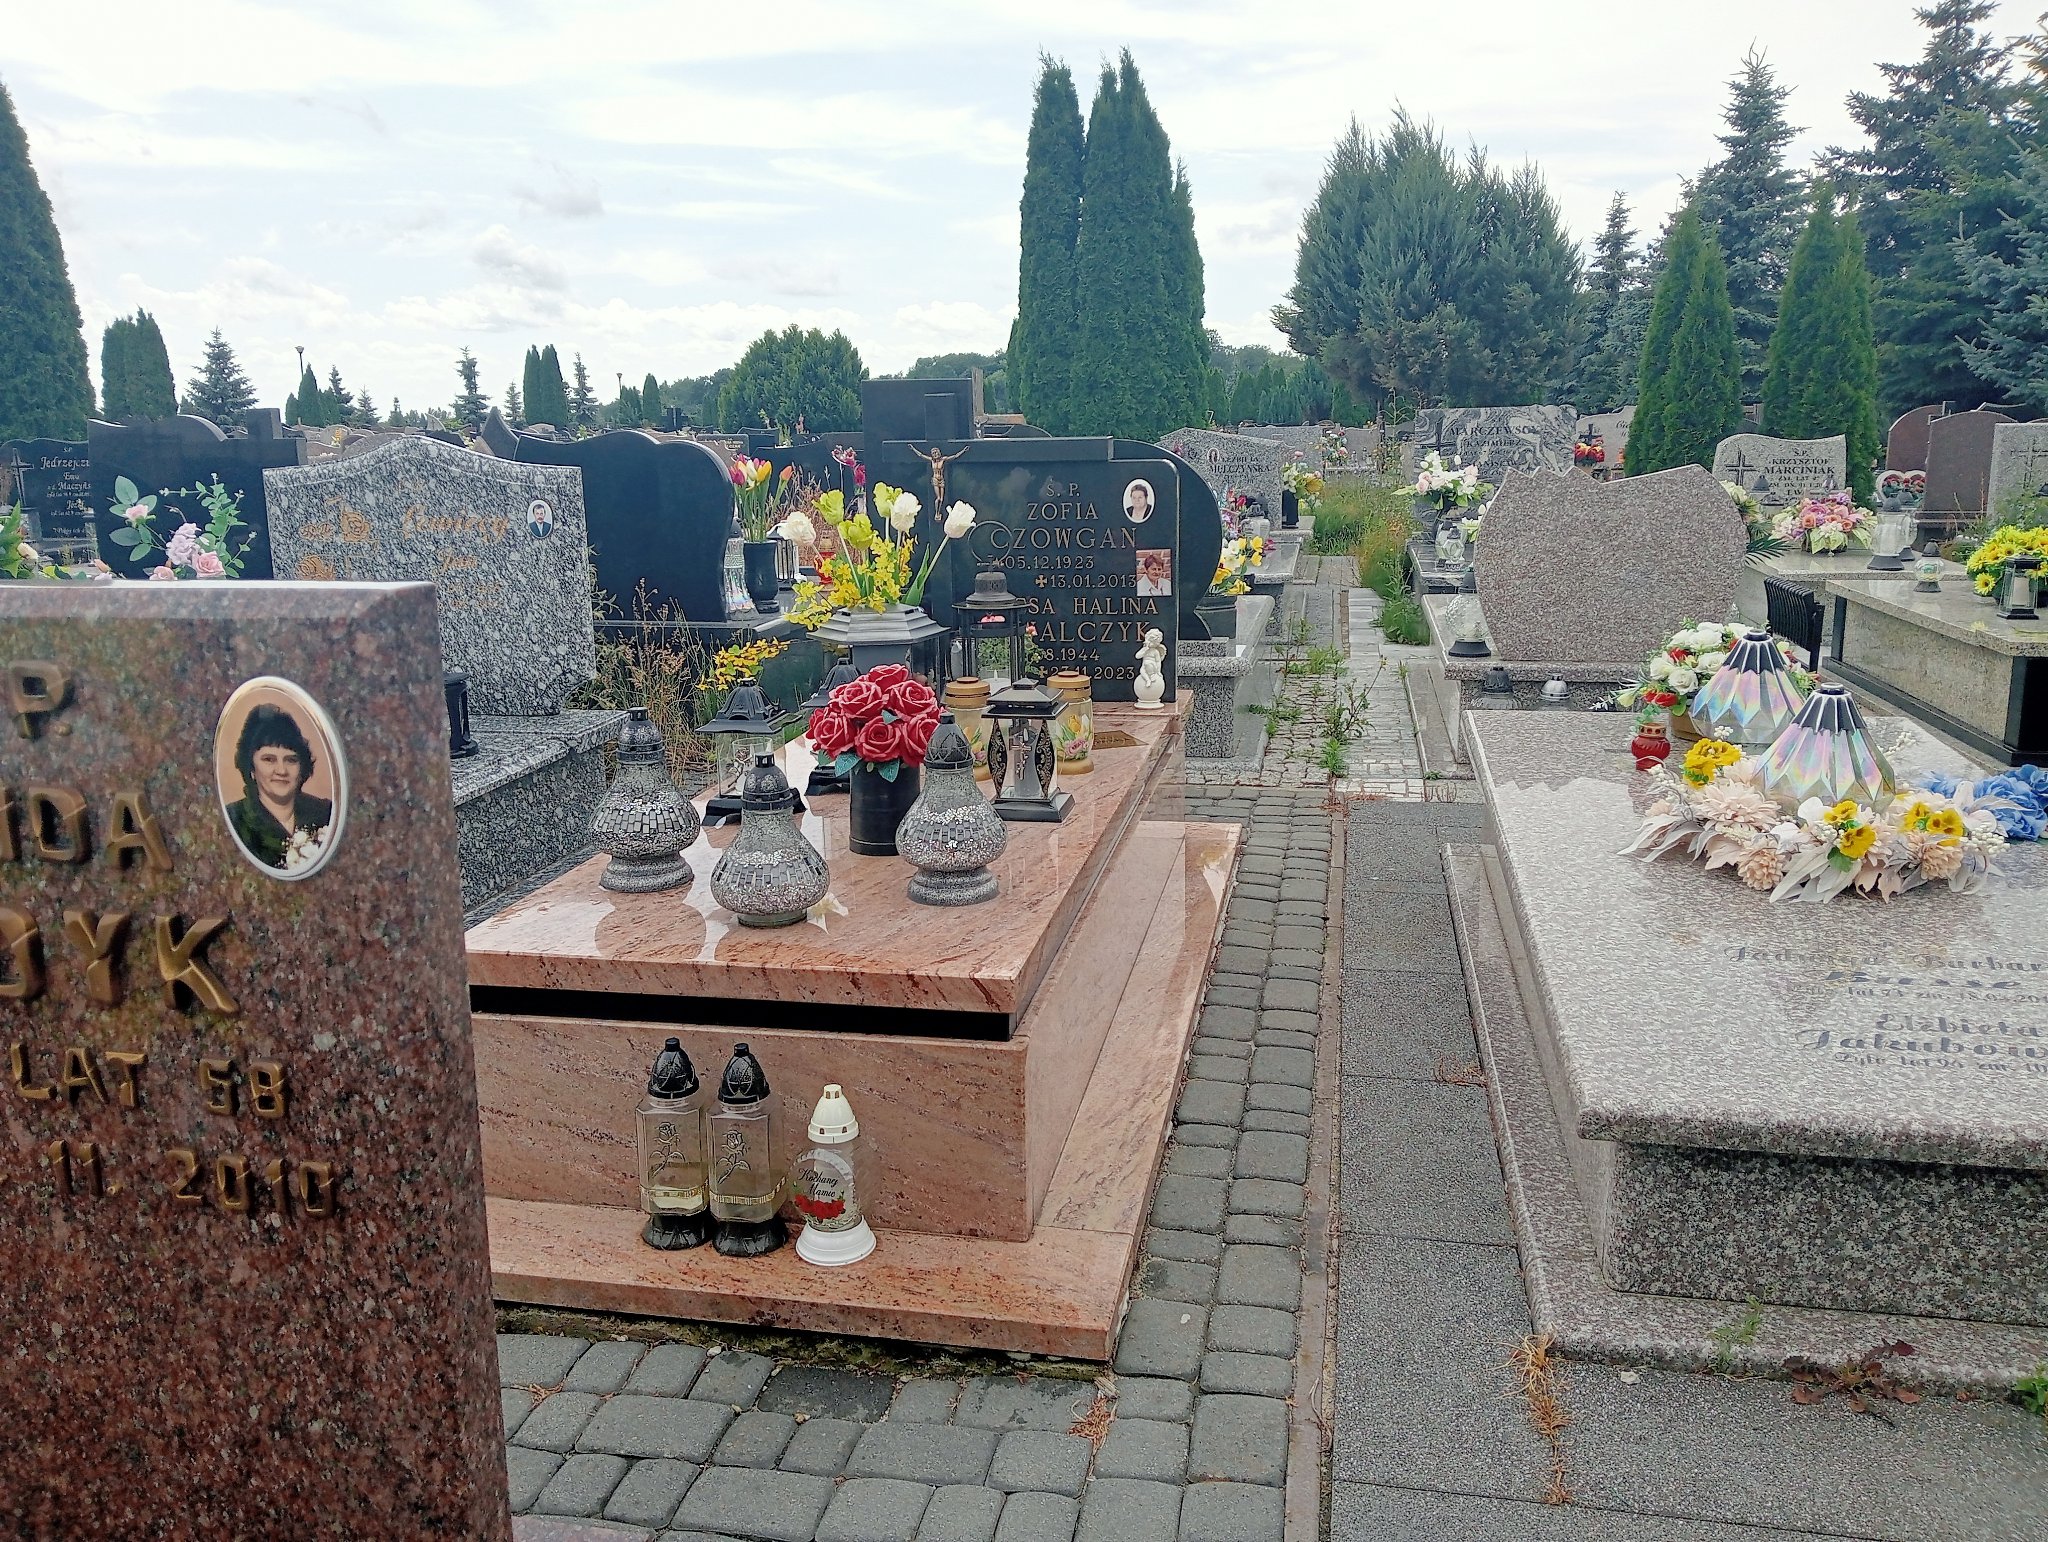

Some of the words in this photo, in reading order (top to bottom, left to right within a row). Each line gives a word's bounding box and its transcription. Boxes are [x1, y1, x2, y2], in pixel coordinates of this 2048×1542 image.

[1027, 502, 1099, 521] ZOFIA
[990, 526, 1138, 550] CZOWGAN
[1005, 555, 1095, 570] 05.12.1923
[1050, 574, 1137, 590] 13.01.2013
[1073, 597, 1159, 615] HALINA
[1030, 621, 1151, 643] ALCZYK
[11, 1042, 148, 1108] LAT
[798, 1168, 839, 1188] Kochanej
[809, 1183, 836, 1198] Mamie
